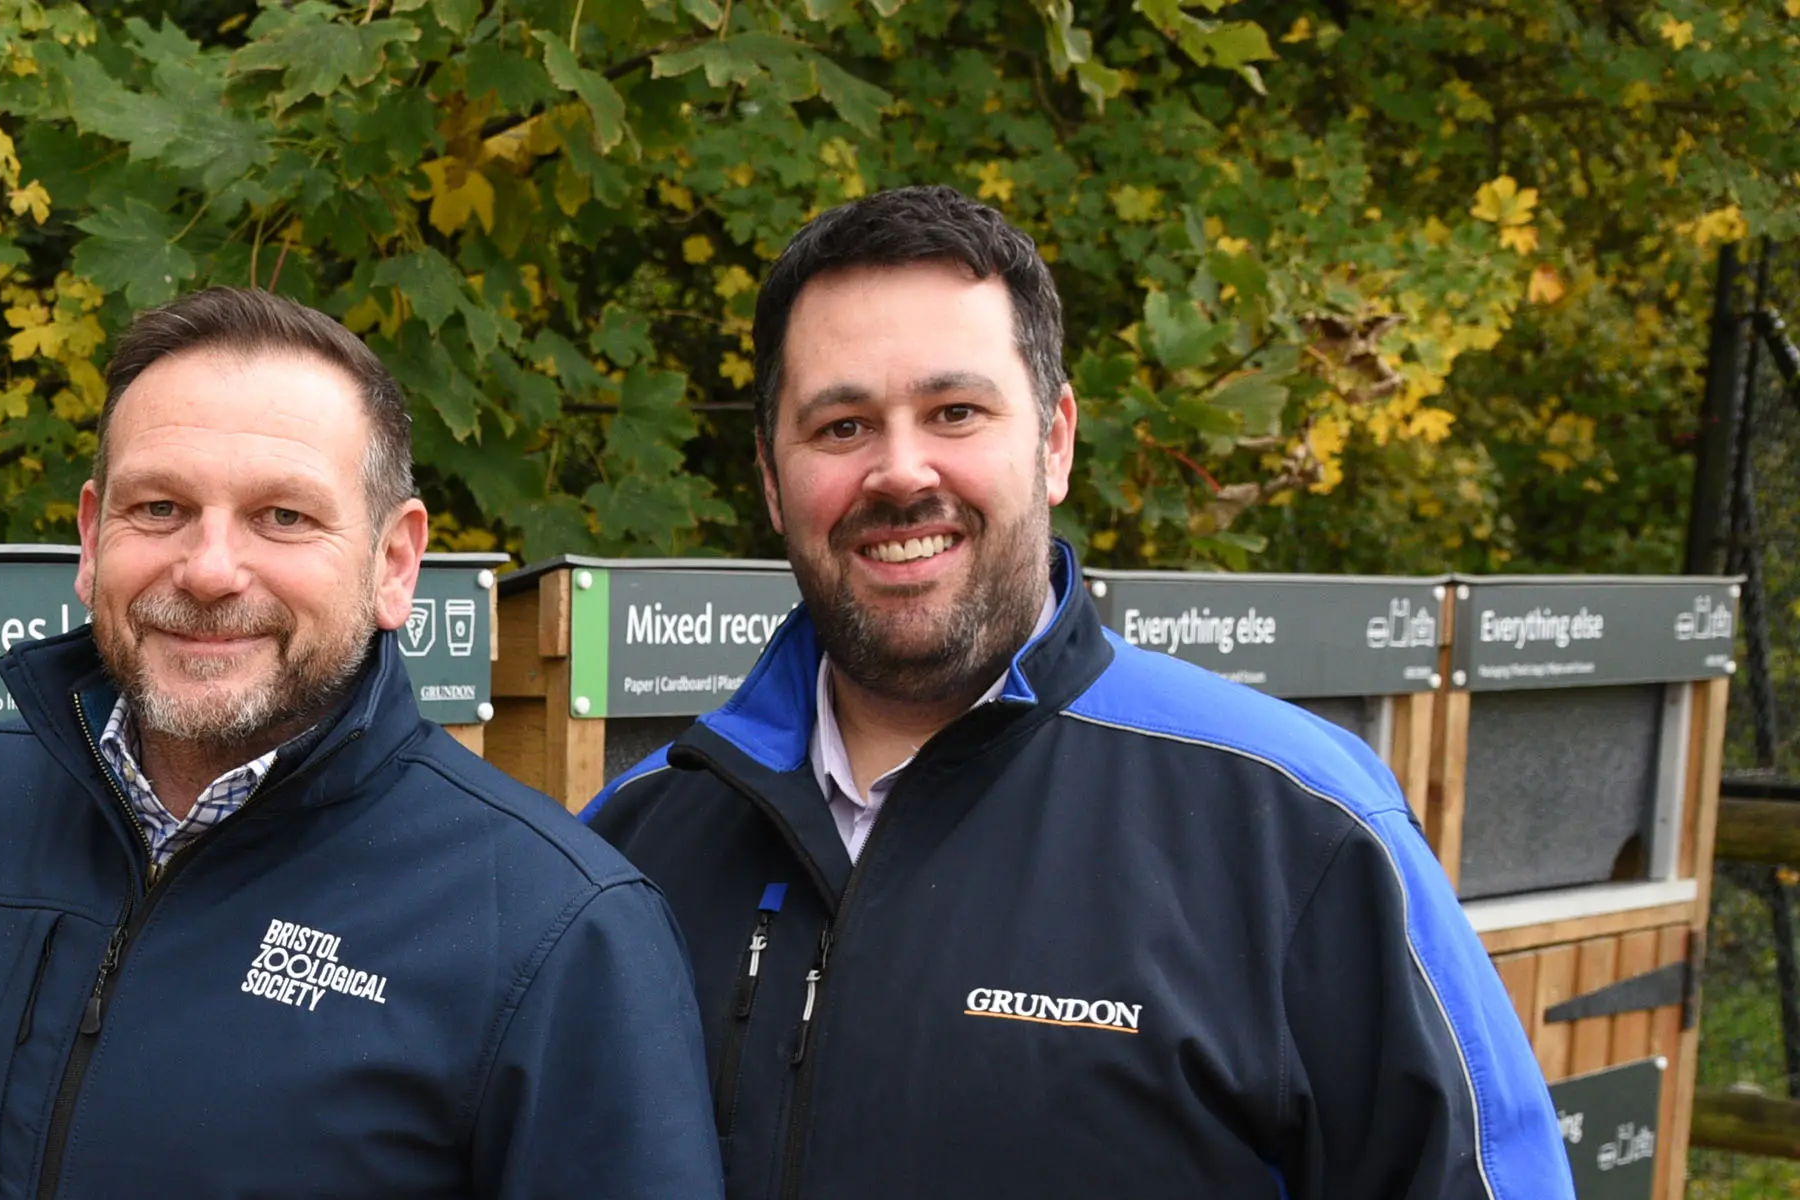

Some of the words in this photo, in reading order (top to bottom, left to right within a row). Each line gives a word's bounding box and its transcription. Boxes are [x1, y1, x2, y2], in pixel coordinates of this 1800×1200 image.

[626, 601, 713, 645] Mixed
[1124, 607, 1235, 653] Everything
[1236, 607, 1277, 643] else
[1480, 607, 1570, 649] Everything
[1570, 607, 1604, 640] else
[624, 676, 654, 696] Paper
[661, 675, 712, 692] Cardboard
[262, 918, 342, 963] BRISTOL
[241, 968, 326, 1012] SOCIETY
[251, 943, 388, 1004] ZOOLOGICAL
[966, 987, 1143, 1029] GRUNDON
